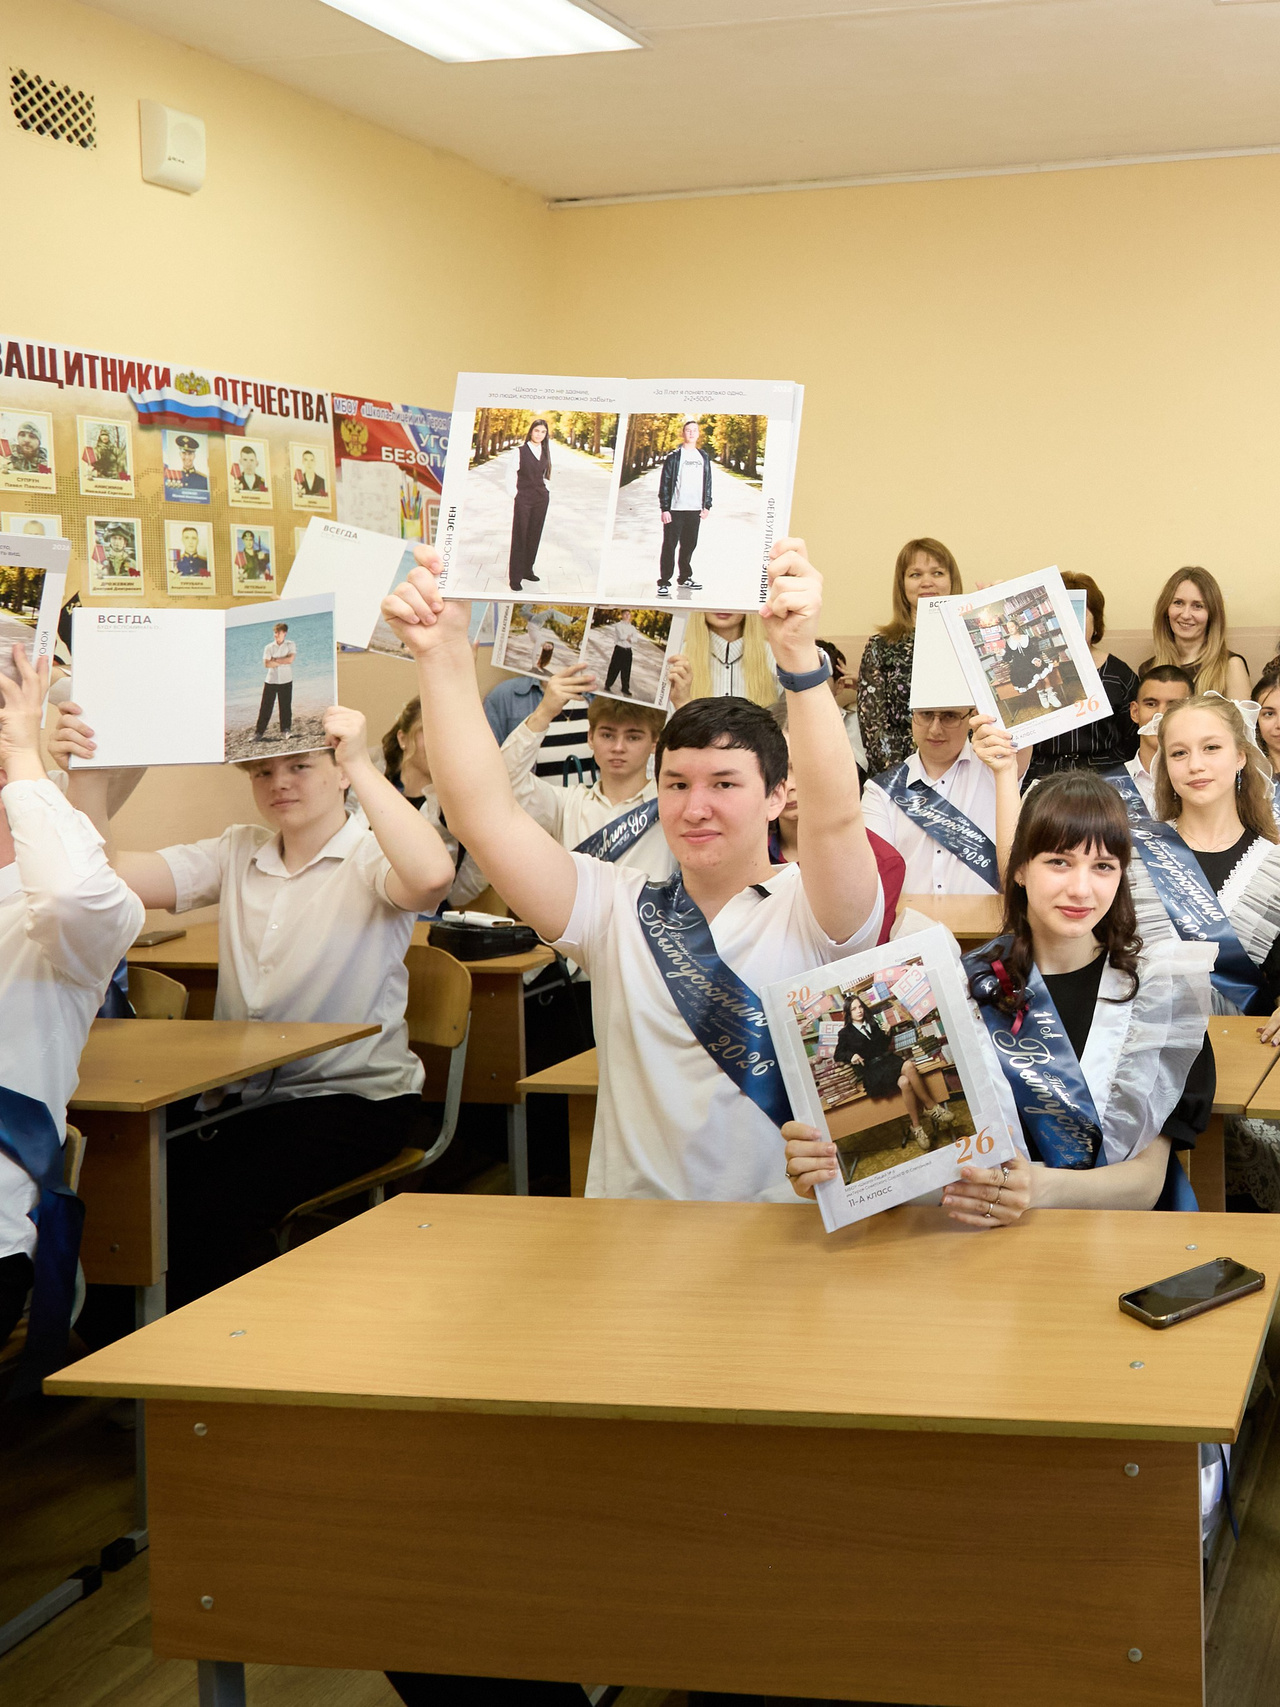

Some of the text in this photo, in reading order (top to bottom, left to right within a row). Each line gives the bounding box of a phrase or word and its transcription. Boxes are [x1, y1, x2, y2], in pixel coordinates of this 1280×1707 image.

[0, 341, 328, 424] АЩИТНИКИ ОТЕЧЕСТВА
[333, 397, 359, 415] МБОУ
[446, 506, 457, 532] ЭЛЕН
[323, 524, 358, 539] ВСЕГДА
[98, 614, 152, 624] ВСЕГДА
[957, 602, 974, 617] 20
[38, 631, 49, 656] КОРО
[1074, 694, 1100, 718] 26
[958, 847, 992, 868] 2026
[639, 902, 769, 1027] Выпускник
[901, 969, 922, 991] ЕГЭ
[786, 985, 811, 1008] 20
[1033, 1011, 1063, 1040] 11А
[707, 1035, 776, 1077] 2026
[954, 1126, 995, 1165] 26
[848, 1185, 893, 1208] 11-А класс
